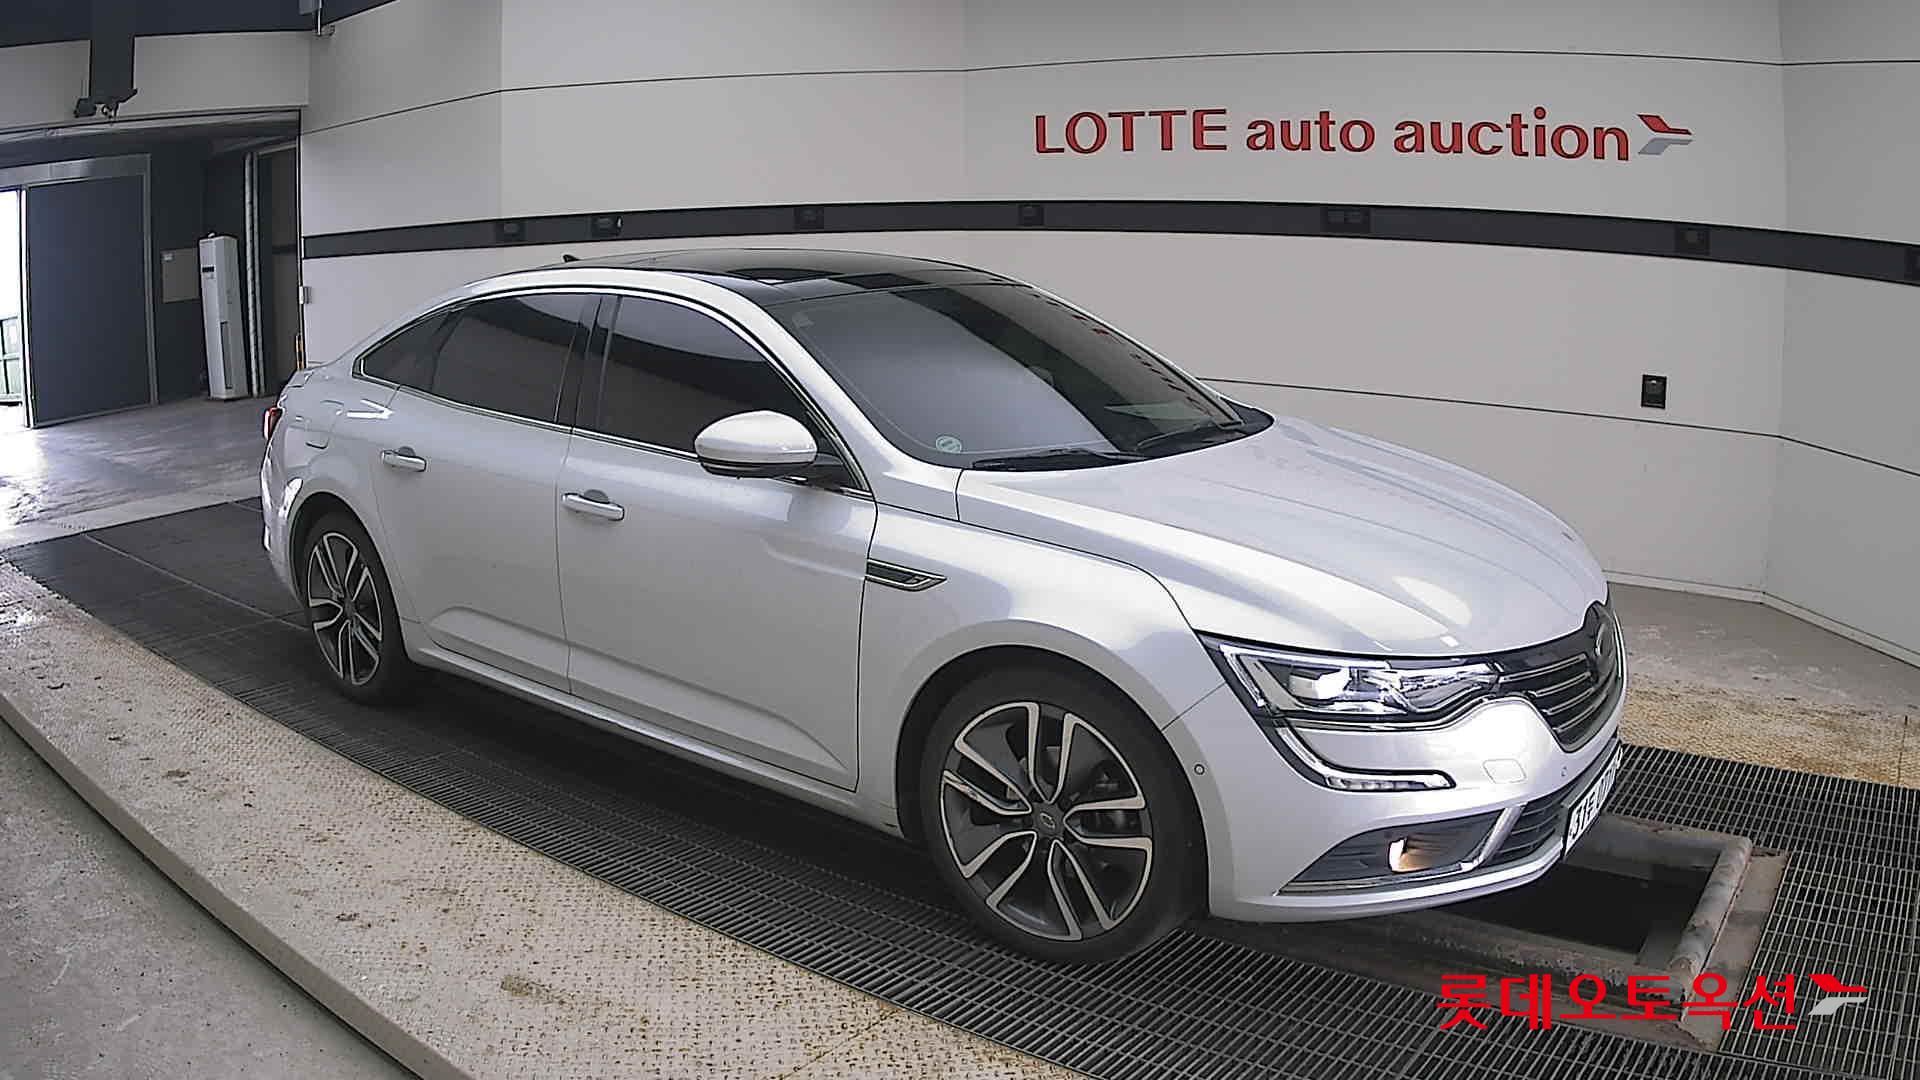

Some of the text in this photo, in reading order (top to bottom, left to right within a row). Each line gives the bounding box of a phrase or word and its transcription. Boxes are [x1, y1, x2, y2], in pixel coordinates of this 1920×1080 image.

[1035, 107, 1630, 161] LOTTE auto auction
